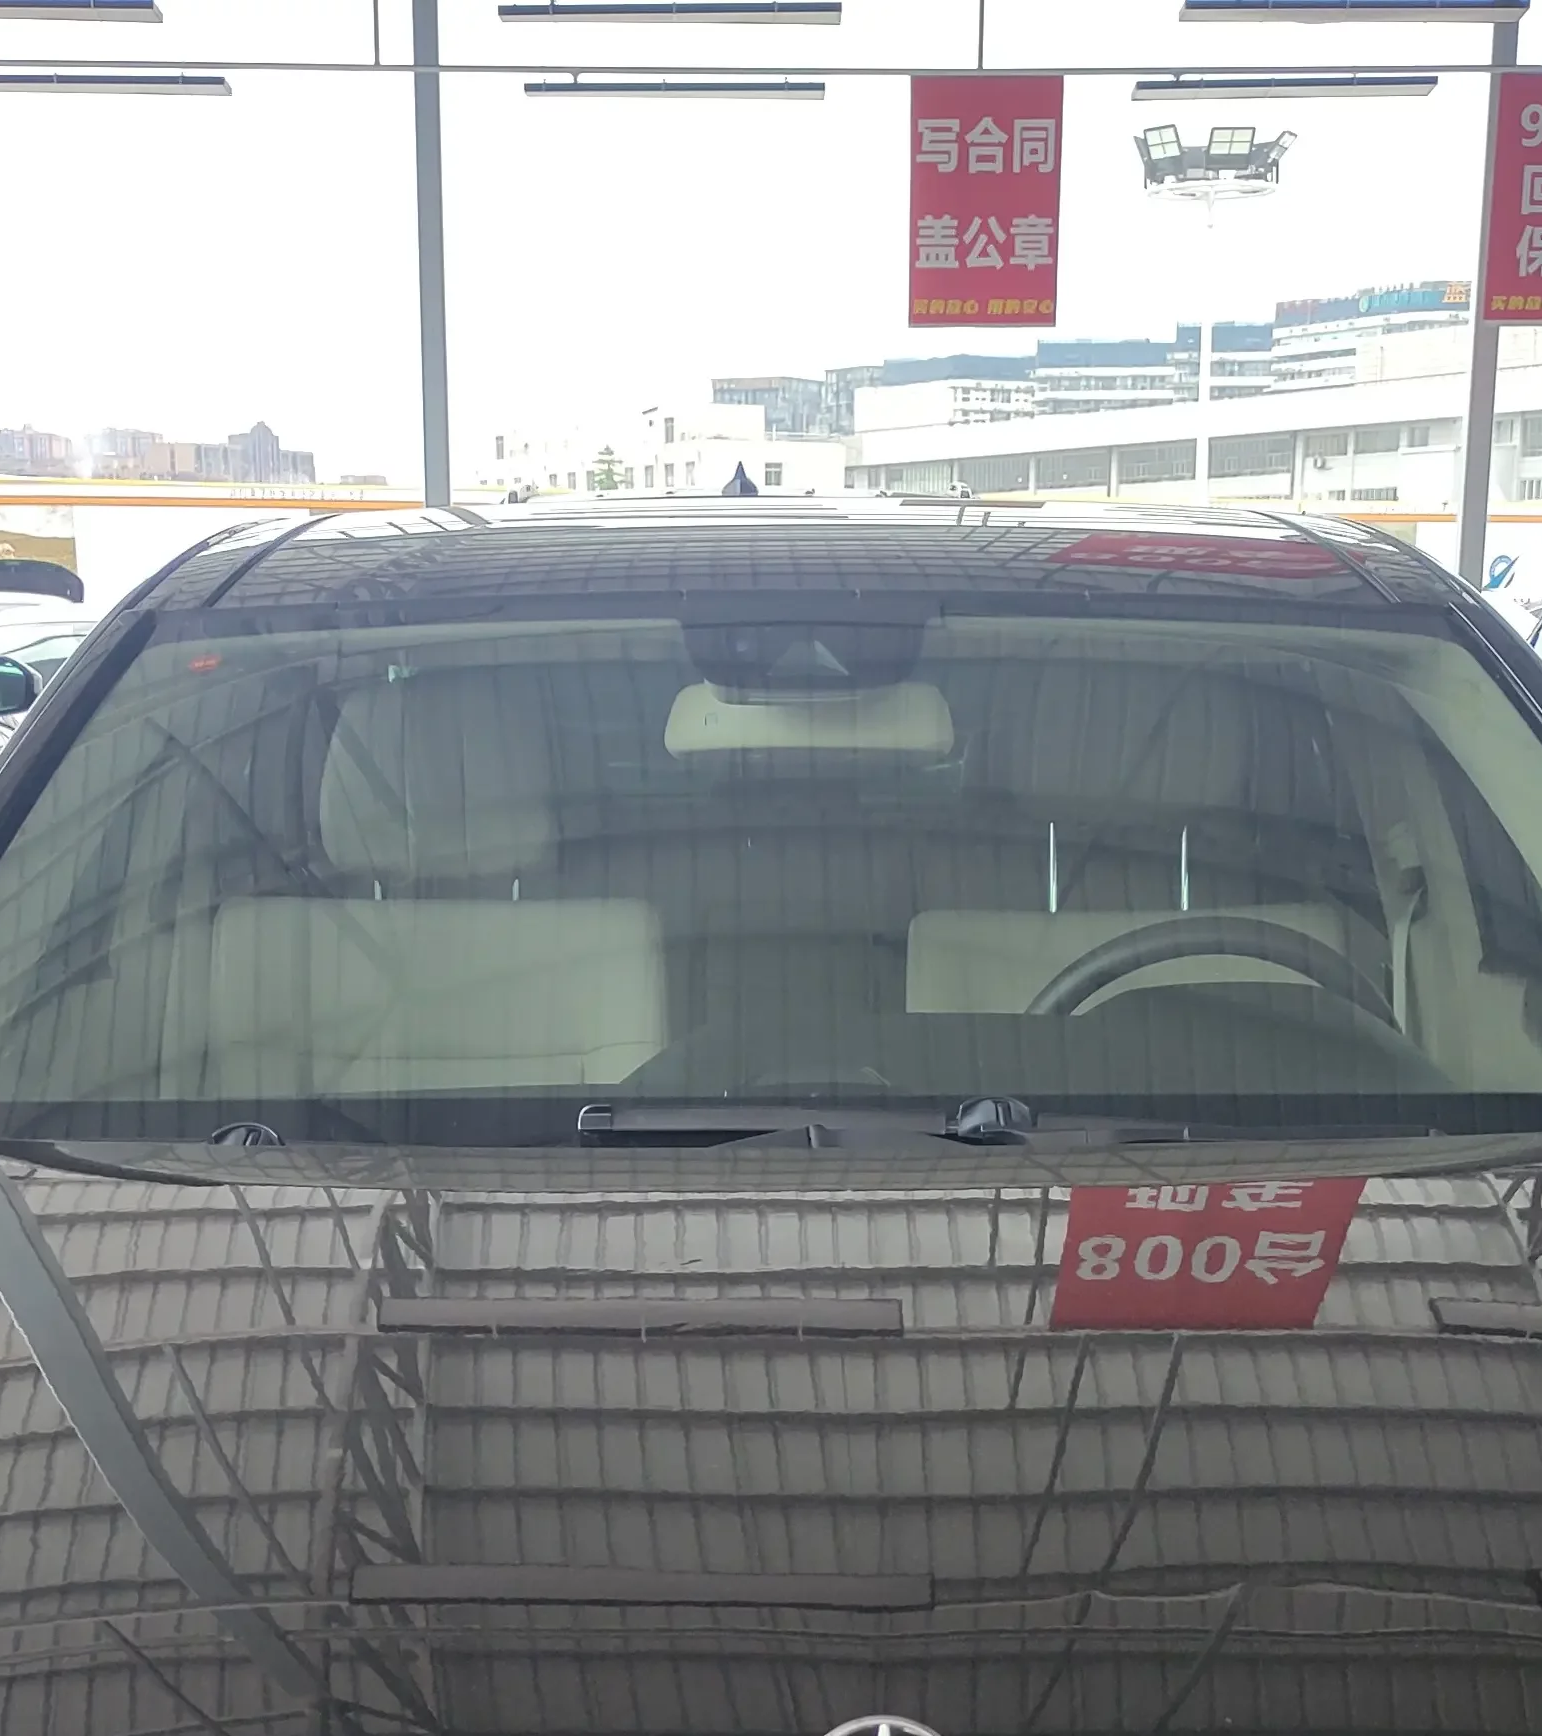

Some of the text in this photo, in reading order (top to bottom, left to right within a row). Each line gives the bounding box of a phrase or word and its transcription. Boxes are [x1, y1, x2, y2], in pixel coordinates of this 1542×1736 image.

[915, 116, 1056, 174] 写合同
[915, 214, 1055, 271] 盖公章
